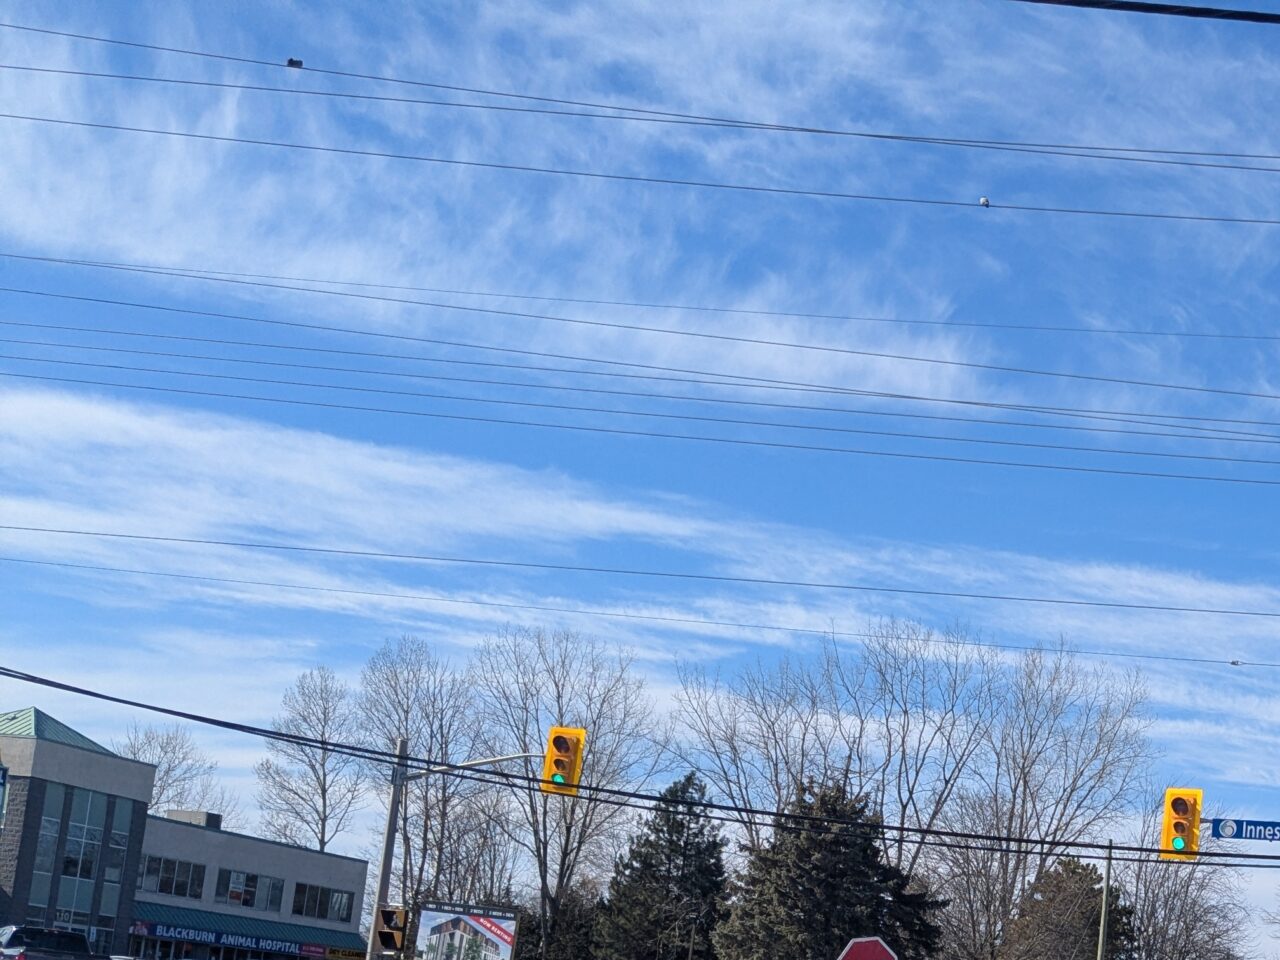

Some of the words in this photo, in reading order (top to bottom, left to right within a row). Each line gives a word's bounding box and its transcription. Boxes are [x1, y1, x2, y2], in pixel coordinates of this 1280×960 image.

[1242, 821, 1280, 840] Innes
[156, 925, 216, 943] BLACKBURN
[220, 934, 257, 948] ANIMAL
[259, 938, 300, 954] HOSPITAL
